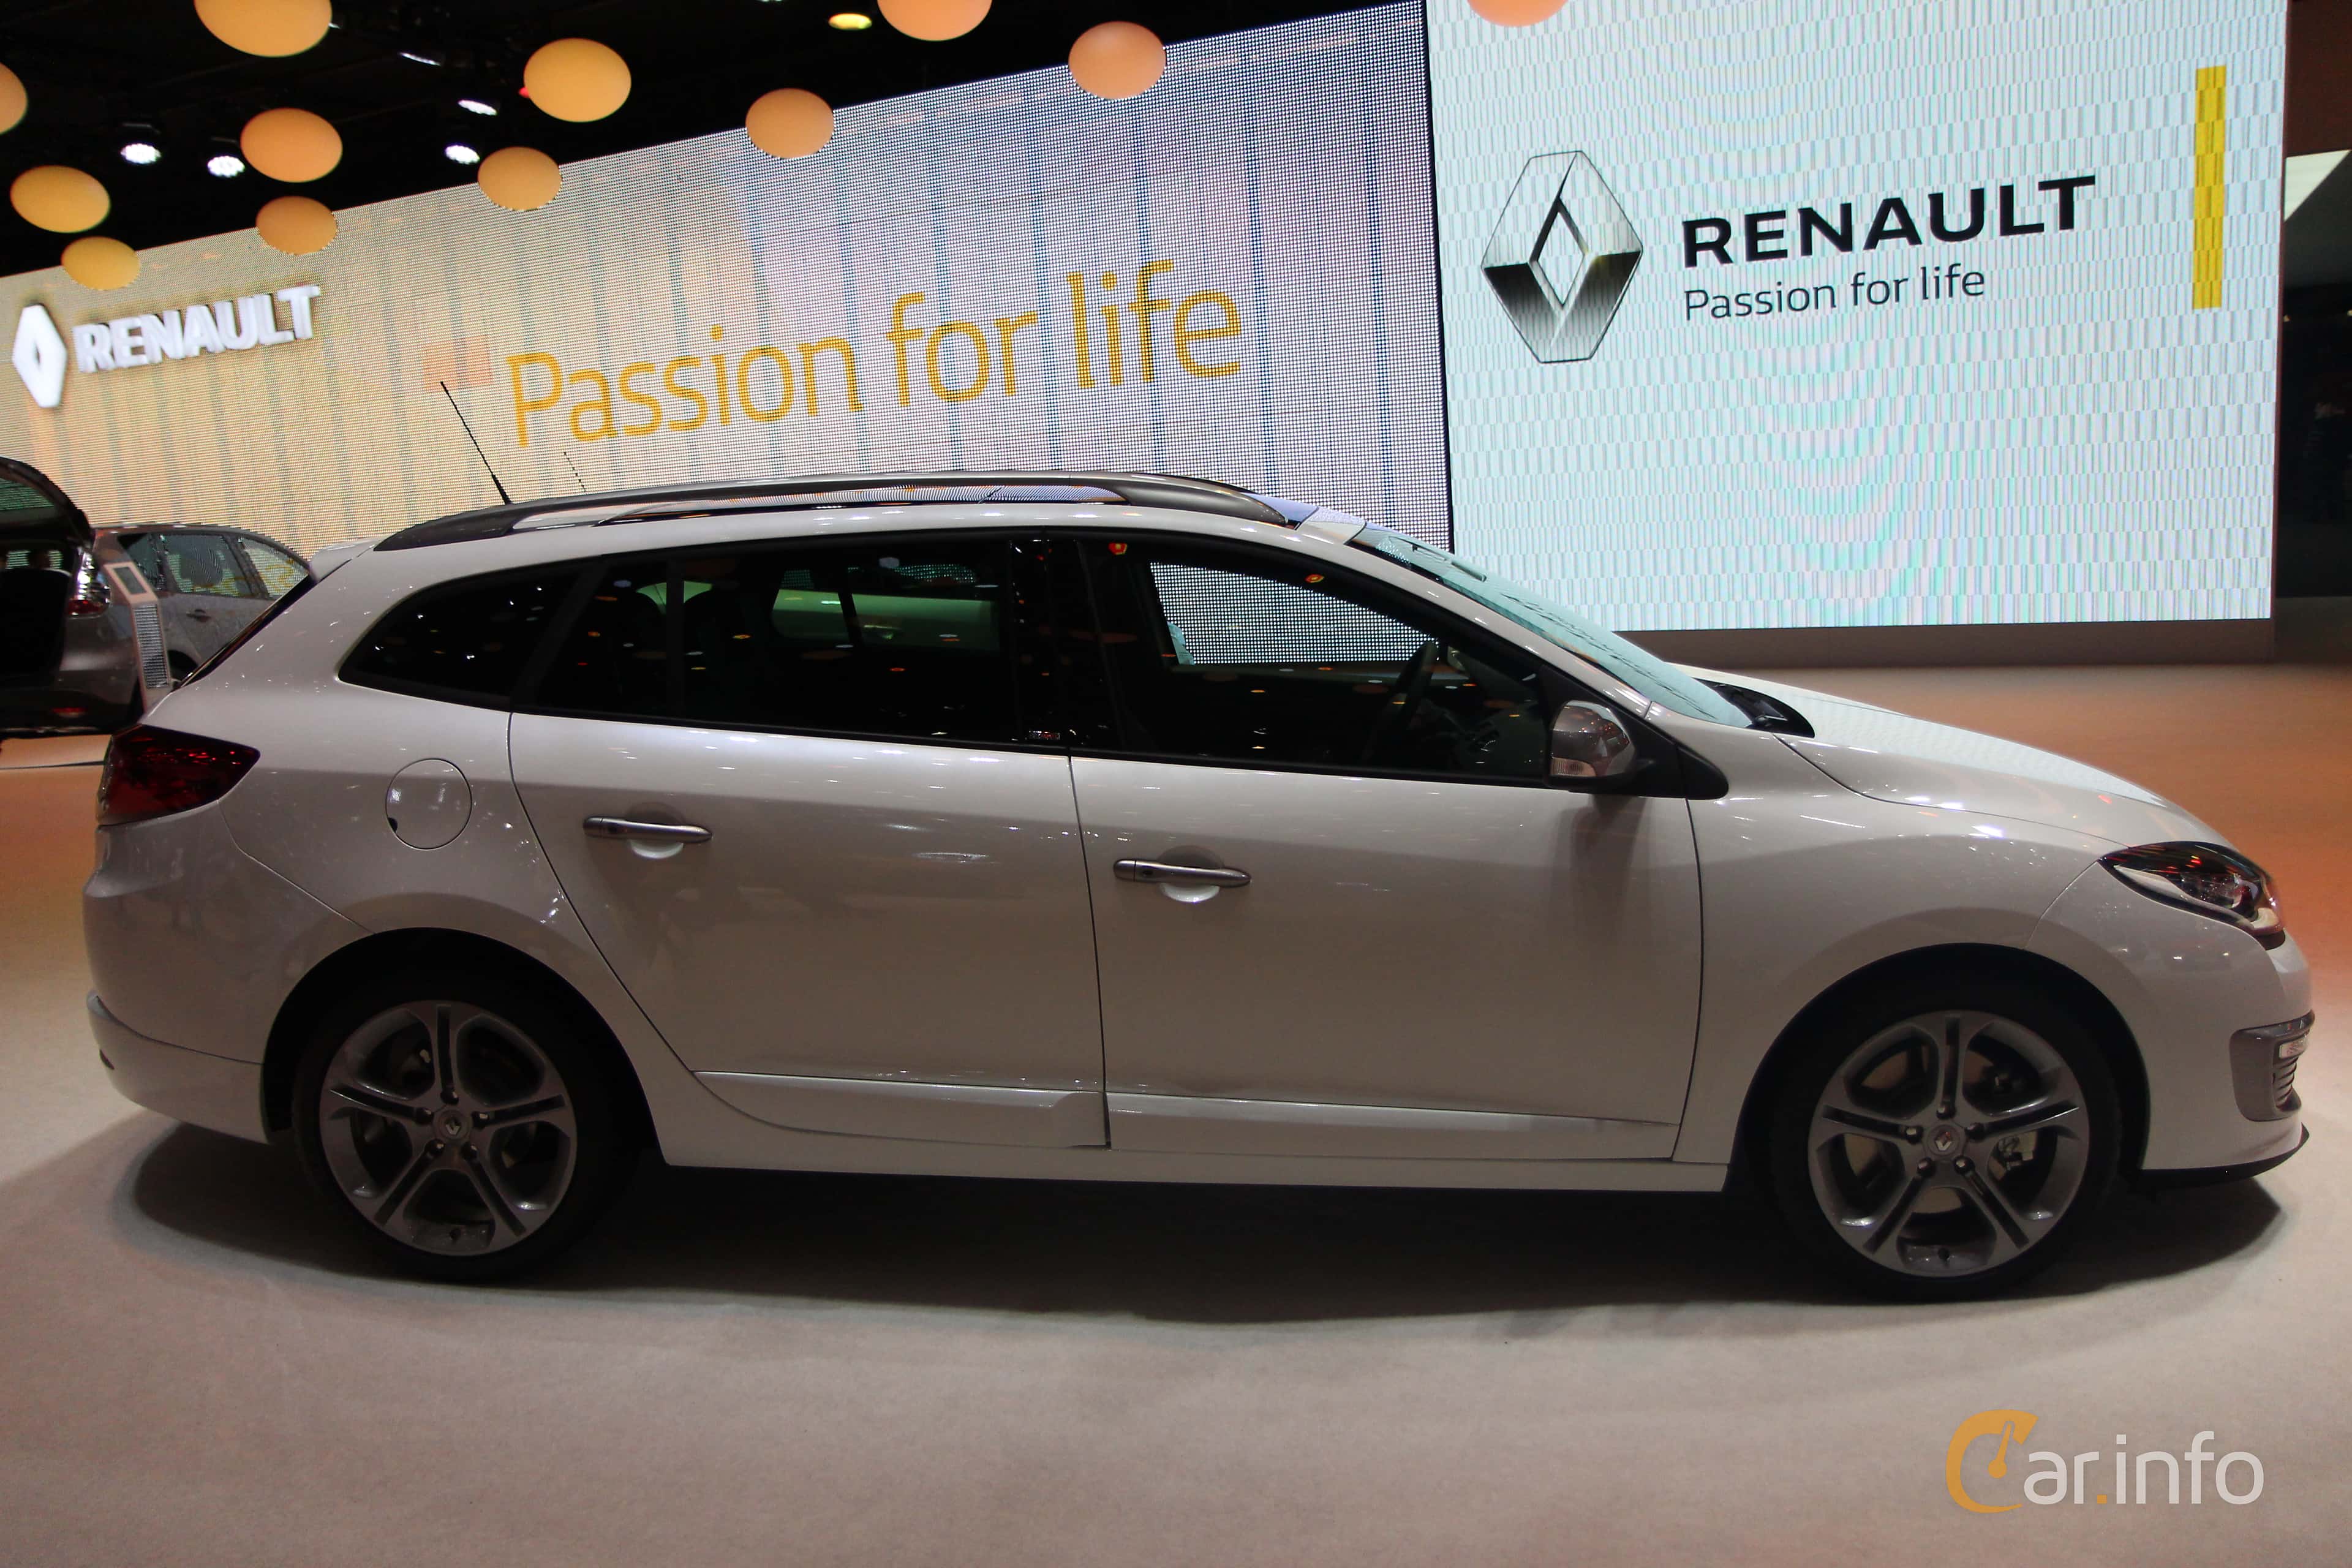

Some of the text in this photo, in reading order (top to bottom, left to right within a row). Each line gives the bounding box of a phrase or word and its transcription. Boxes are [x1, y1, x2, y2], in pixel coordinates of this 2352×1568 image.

[1683, 175, 2095, 268] RENAULT
[72, 285, 320, 373] RENAULT
[1684, 263, 1985, 320] Passion for life
[506, 259, 1242, 448] Passion for life
